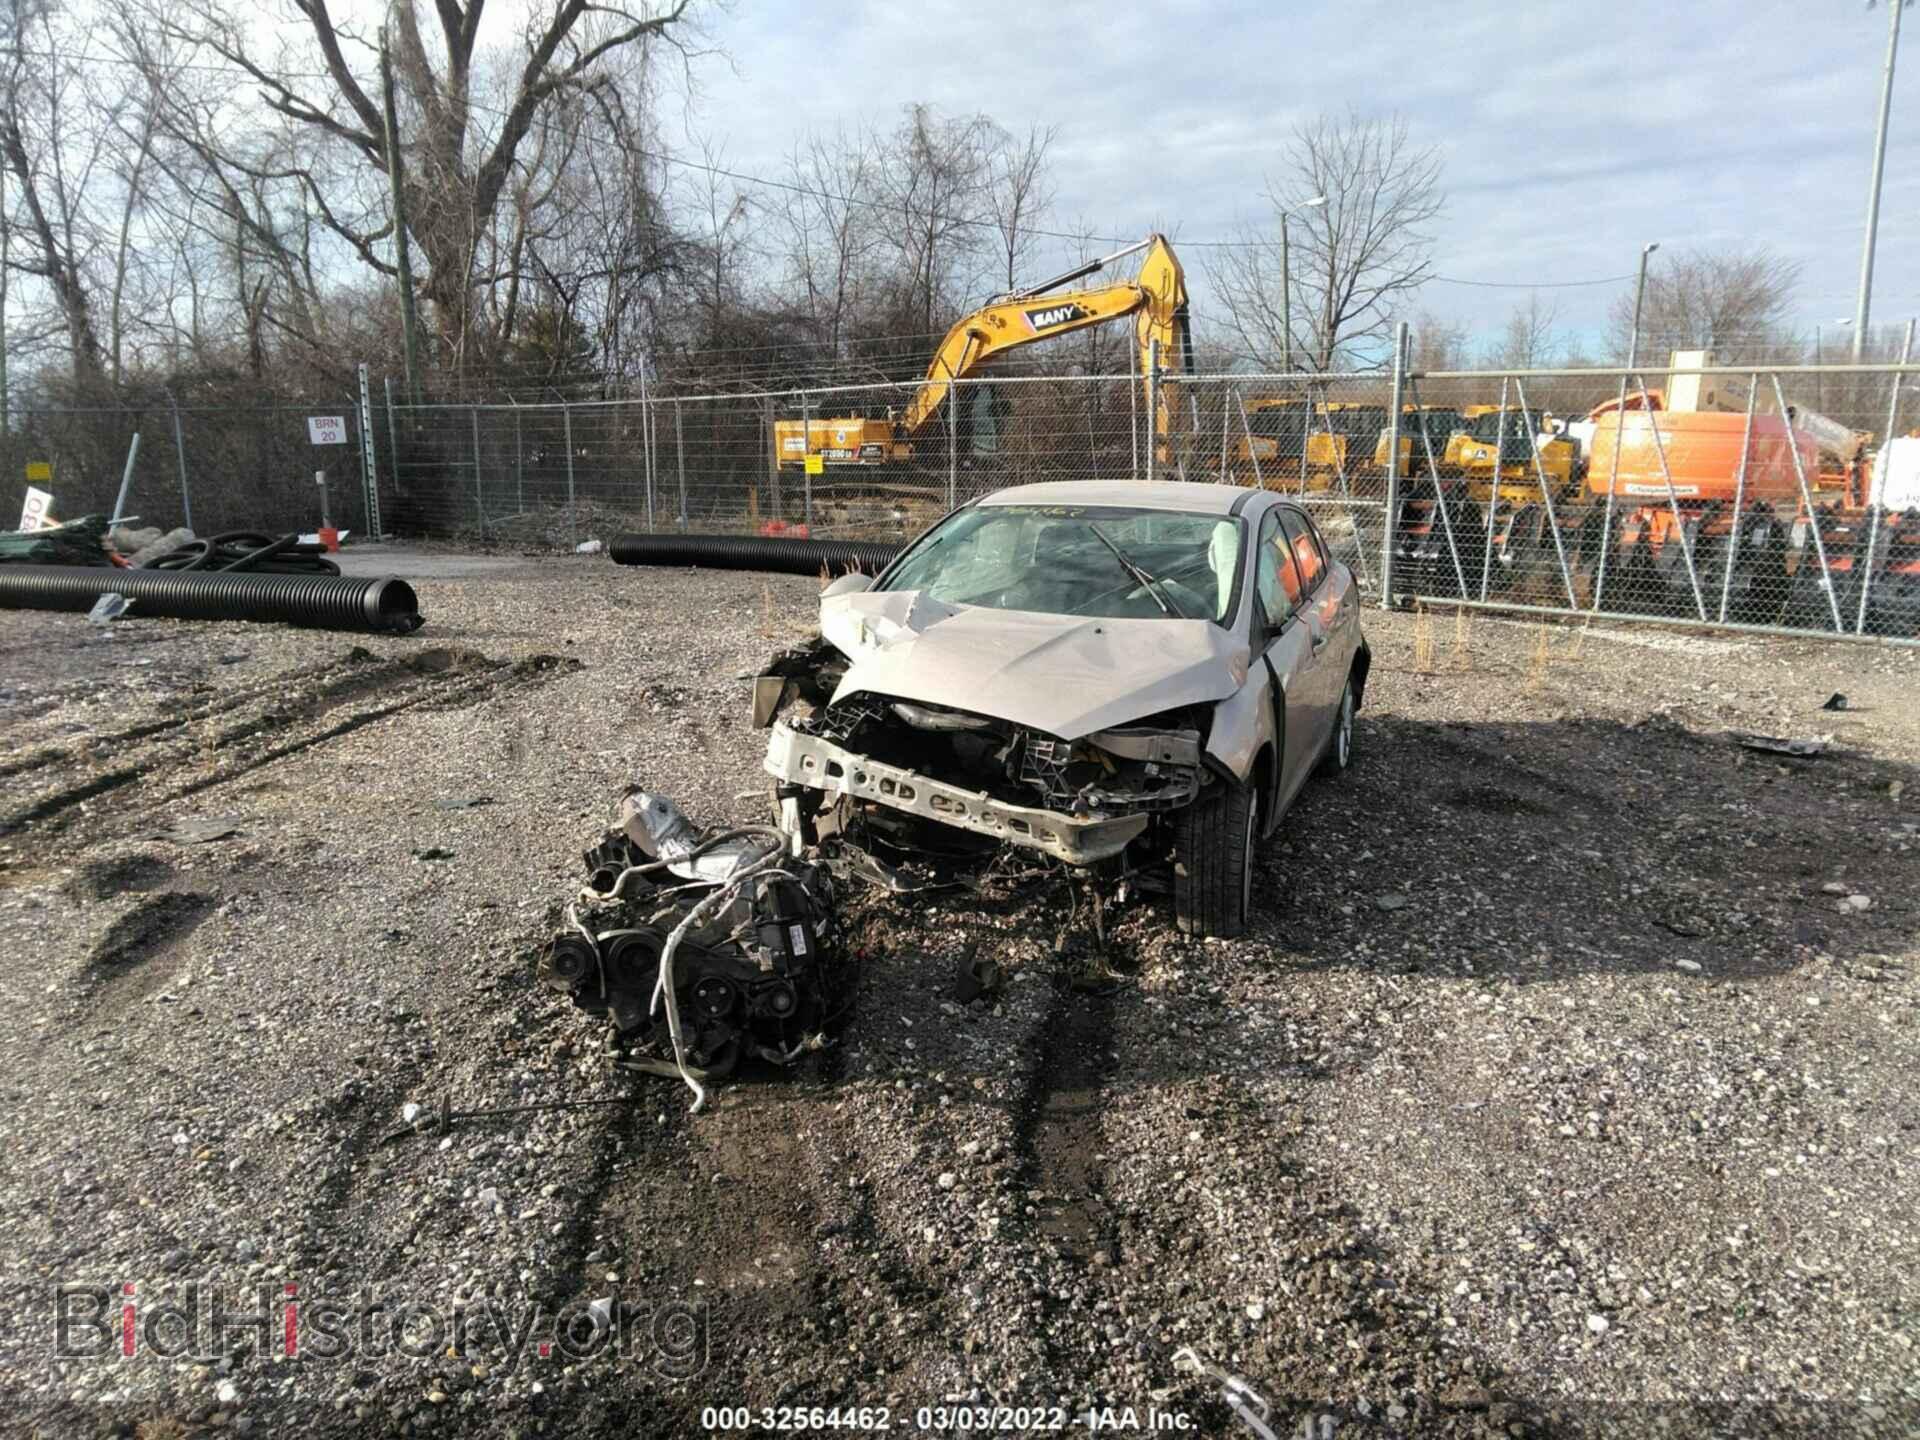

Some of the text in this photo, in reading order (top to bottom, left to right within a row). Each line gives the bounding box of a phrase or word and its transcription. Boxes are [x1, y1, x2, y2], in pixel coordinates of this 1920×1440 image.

[1033, 305, 1074, 327] SANY
[314, 418, 339, 430] BRN
[320, 431, 337, 442] 20
